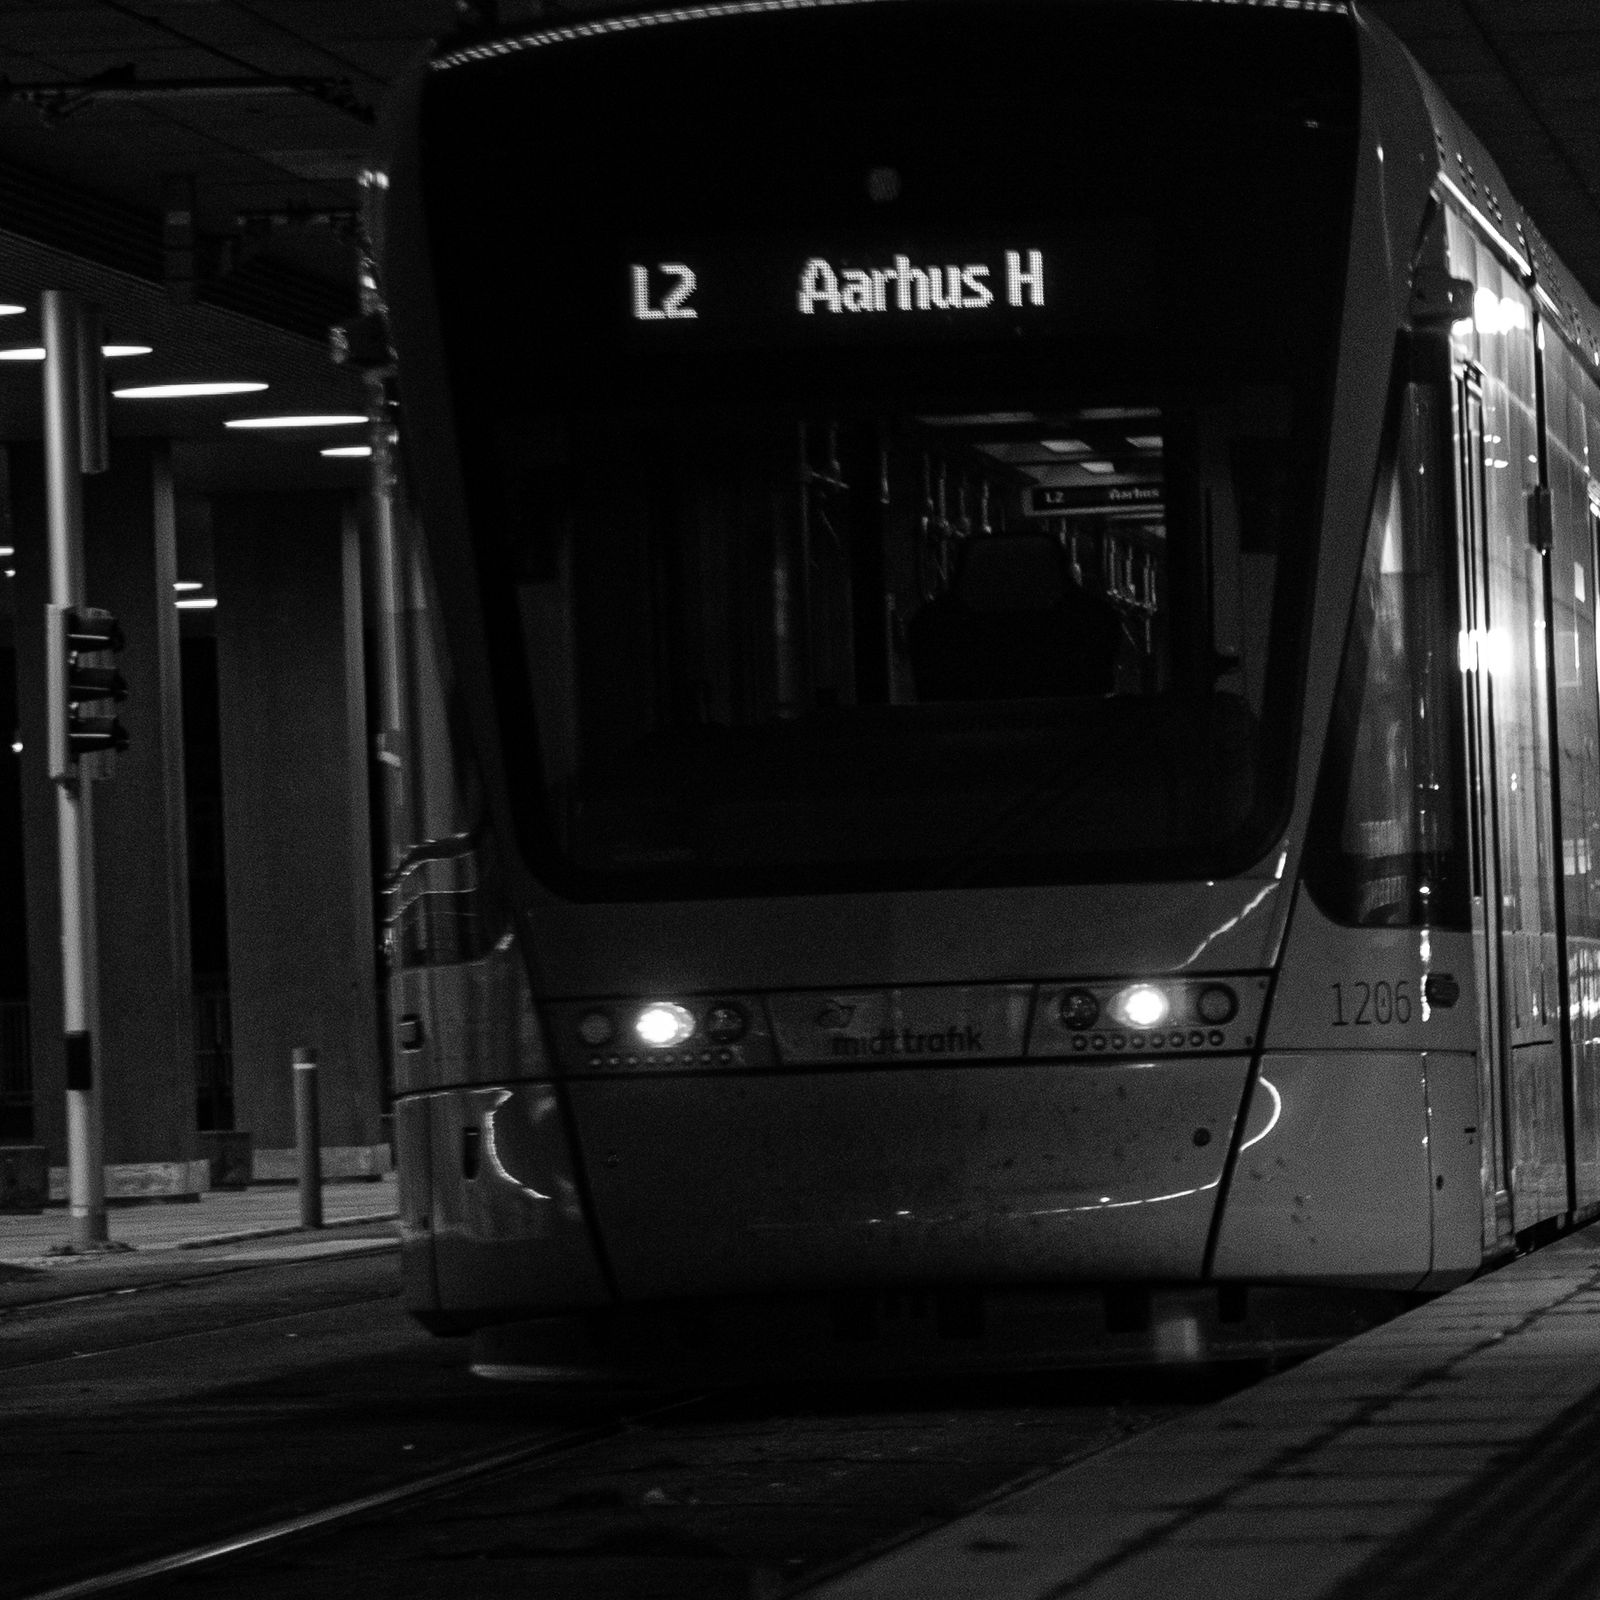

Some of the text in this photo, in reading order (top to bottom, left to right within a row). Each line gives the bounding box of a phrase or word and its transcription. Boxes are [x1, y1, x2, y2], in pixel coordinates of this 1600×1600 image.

[631, 248, 1045, 320] L2 Aarhus H
[1045, 491, 1064, 503] L2
[1331, 981, 1411, 1026] 1206
